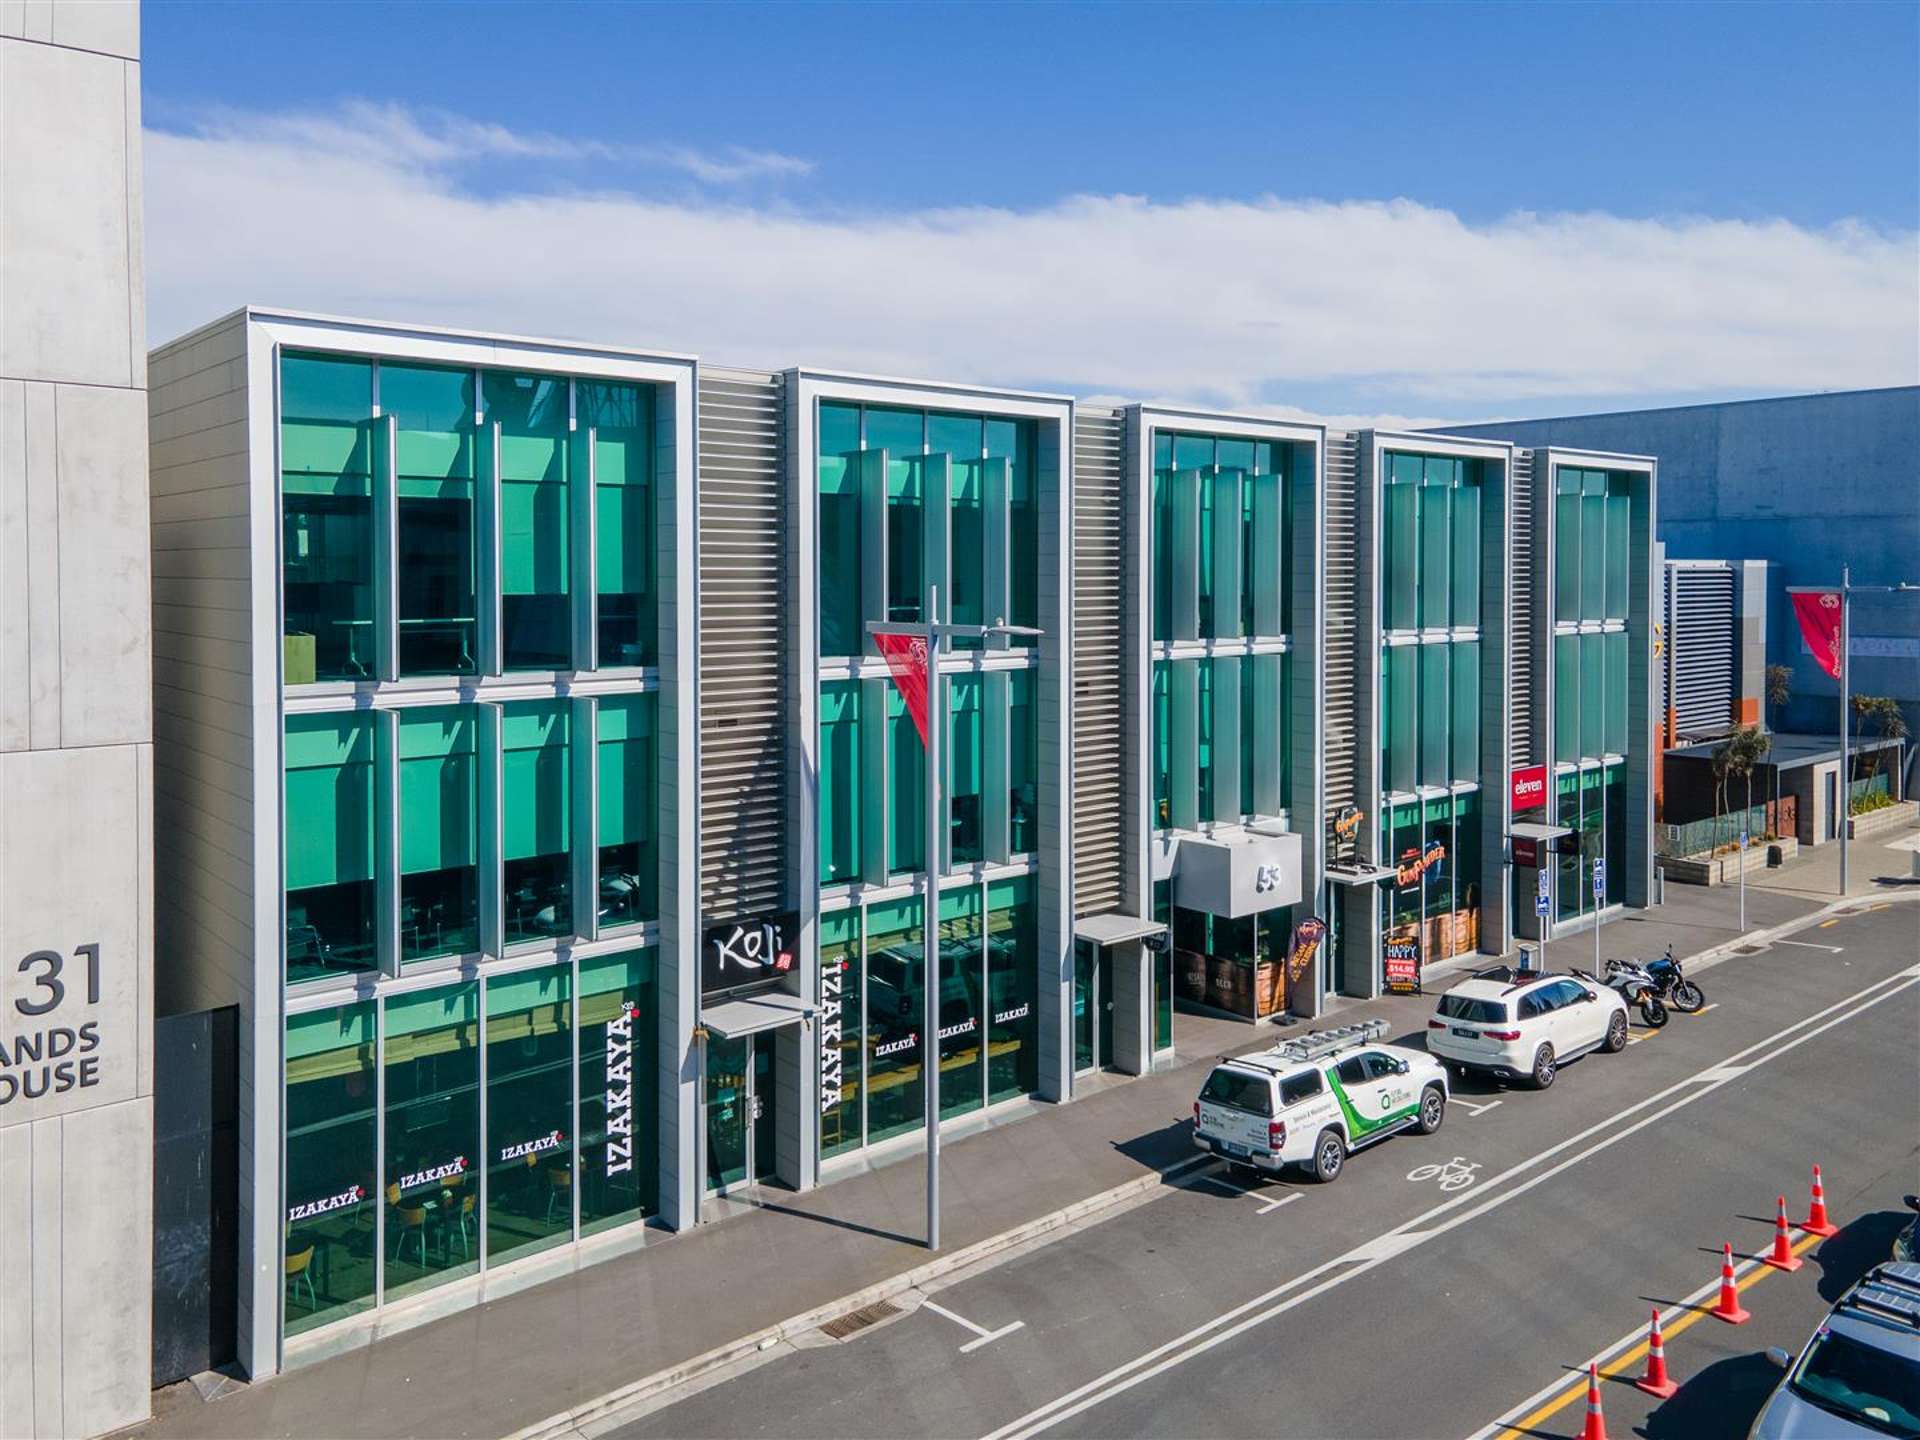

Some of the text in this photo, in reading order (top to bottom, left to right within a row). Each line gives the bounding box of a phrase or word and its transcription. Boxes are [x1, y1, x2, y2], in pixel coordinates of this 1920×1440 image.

[1515, 779, 1542, 795] eleven
[1387, 944, 1417, 958] HAPPY
[15, 943, 100, 1017] 31
[994, 1007, 1029, 1024] IZAKAYA
[820, 964, 843, 1113] IZAKAYA
[875, 1038, 916, 1057] IZAKAYA
[607, 1015, 633, 1177] IZAKAYA
[501, 1135, 559, 1161] IZAKAYA
[400, 1160, 464, 1189] IZAKAYA
[289, 1190, 360, 1221] IZAKAYA
